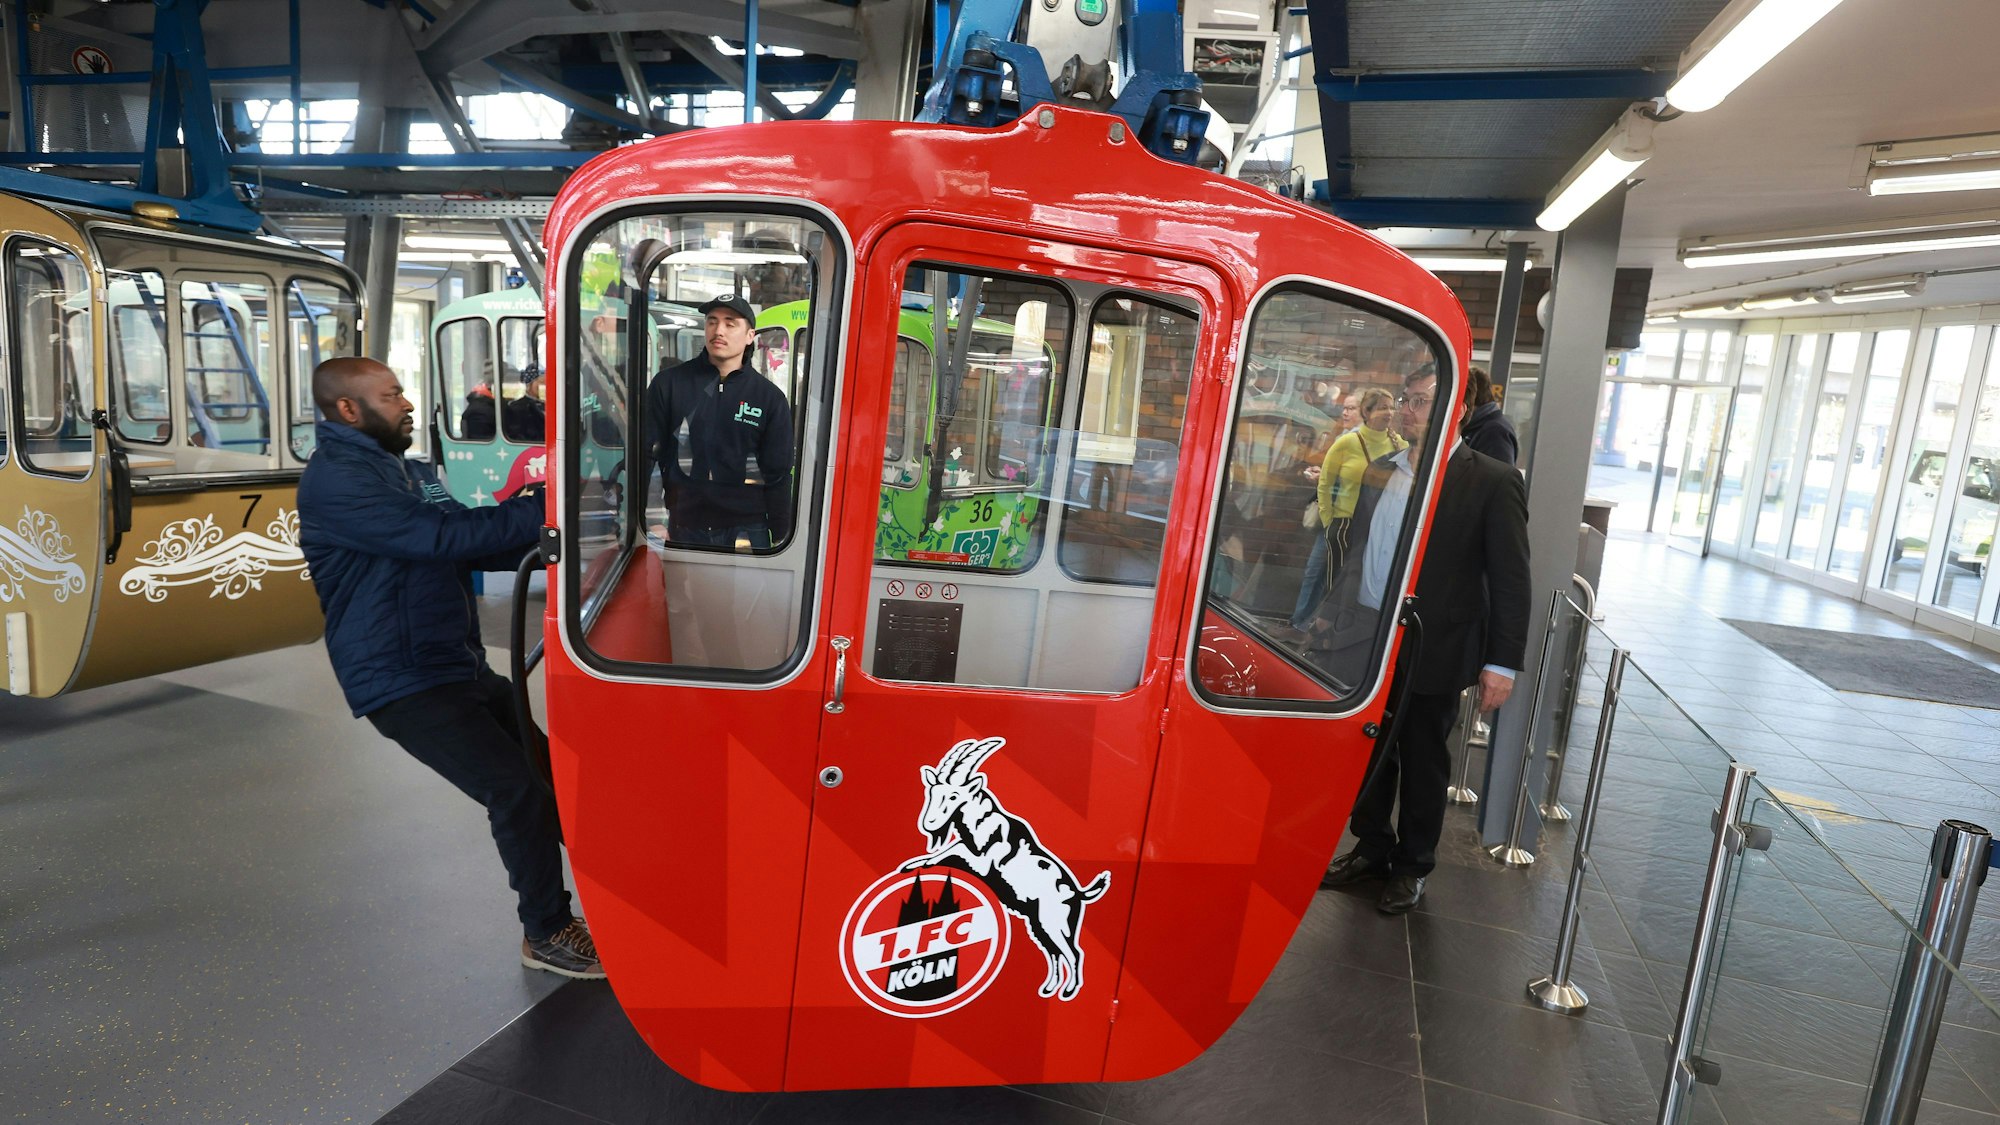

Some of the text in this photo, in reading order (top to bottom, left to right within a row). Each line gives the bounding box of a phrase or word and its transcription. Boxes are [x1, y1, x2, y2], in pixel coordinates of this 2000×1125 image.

[734, 401, 763, 418] jto
[240, 494, 262, 528] 7
[969, 499, 993, 523] 36
[887, 959, 958, 993] KÖLN
